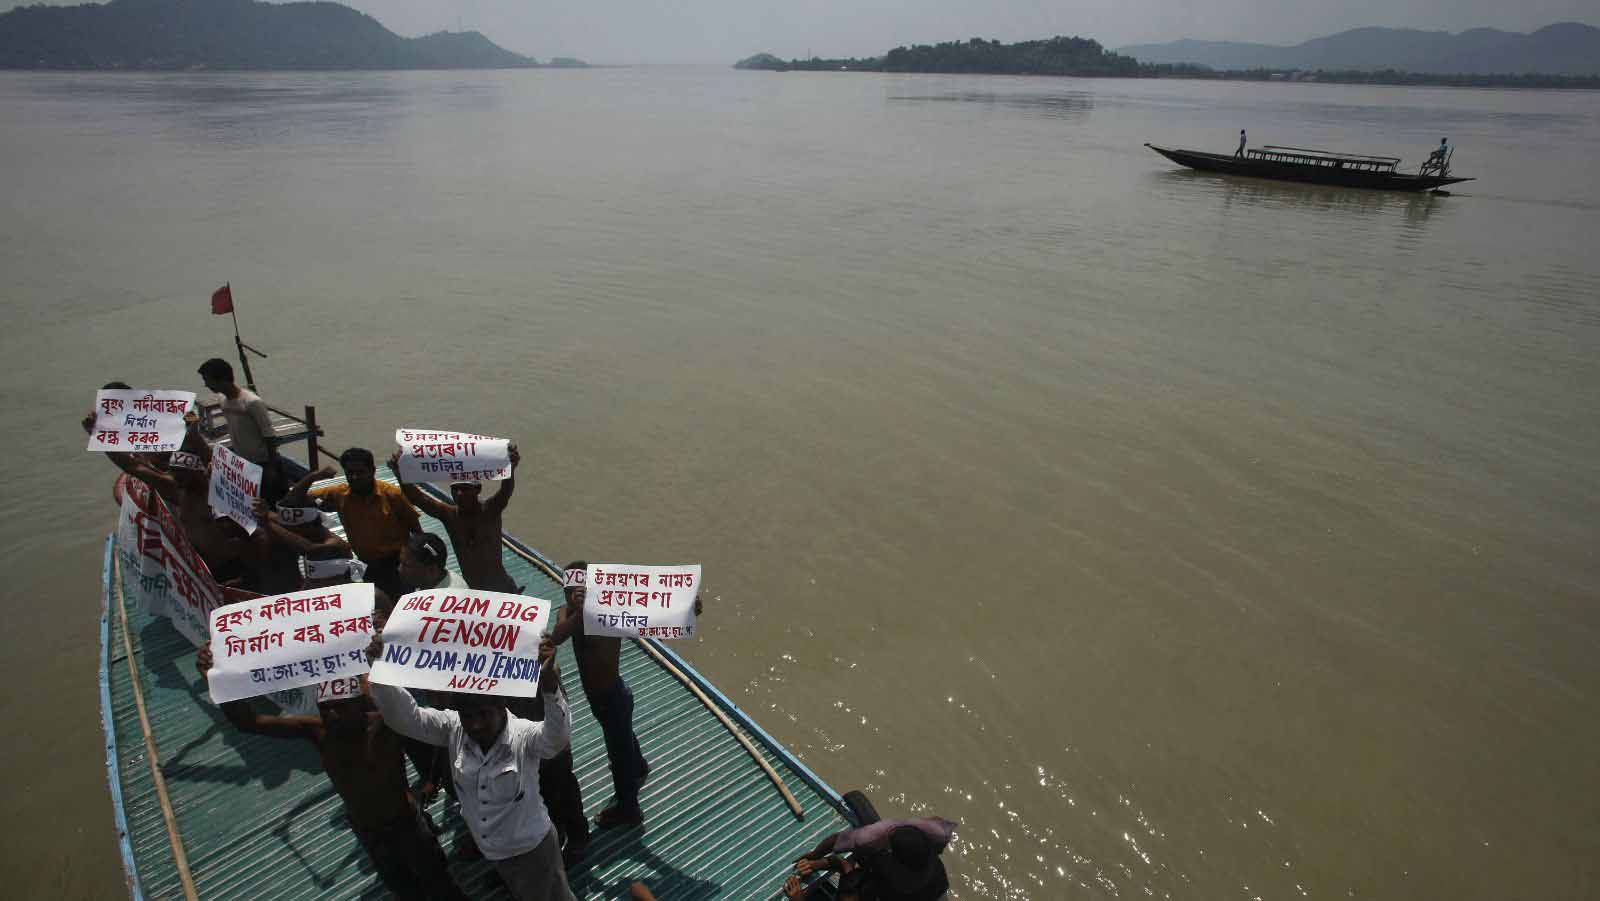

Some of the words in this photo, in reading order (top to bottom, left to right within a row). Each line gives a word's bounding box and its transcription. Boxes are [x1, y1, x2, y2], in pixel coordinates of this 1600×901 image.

[102, 398, 123, 416] বৃহৎ
[97, 431, 120, 445] বন্ধ
[657, 573, 694, 588] নামত
[215, 608, 253, 633] বৃহৎ
[402, 595, 435, 612] BIG
[439, 595, 491, 617] DAM
[496, 601, 540, 622] BIG
[224, 629, 285, 658] নির্মাণ
[293, 623, 325, 644] বন্ধ
[417, 616, 521, 652] TENSION
[385, 644, 412, 666] NO
[487, 651, 542, 683] TENSION
[447, 674, 500, 692] AJYCP
